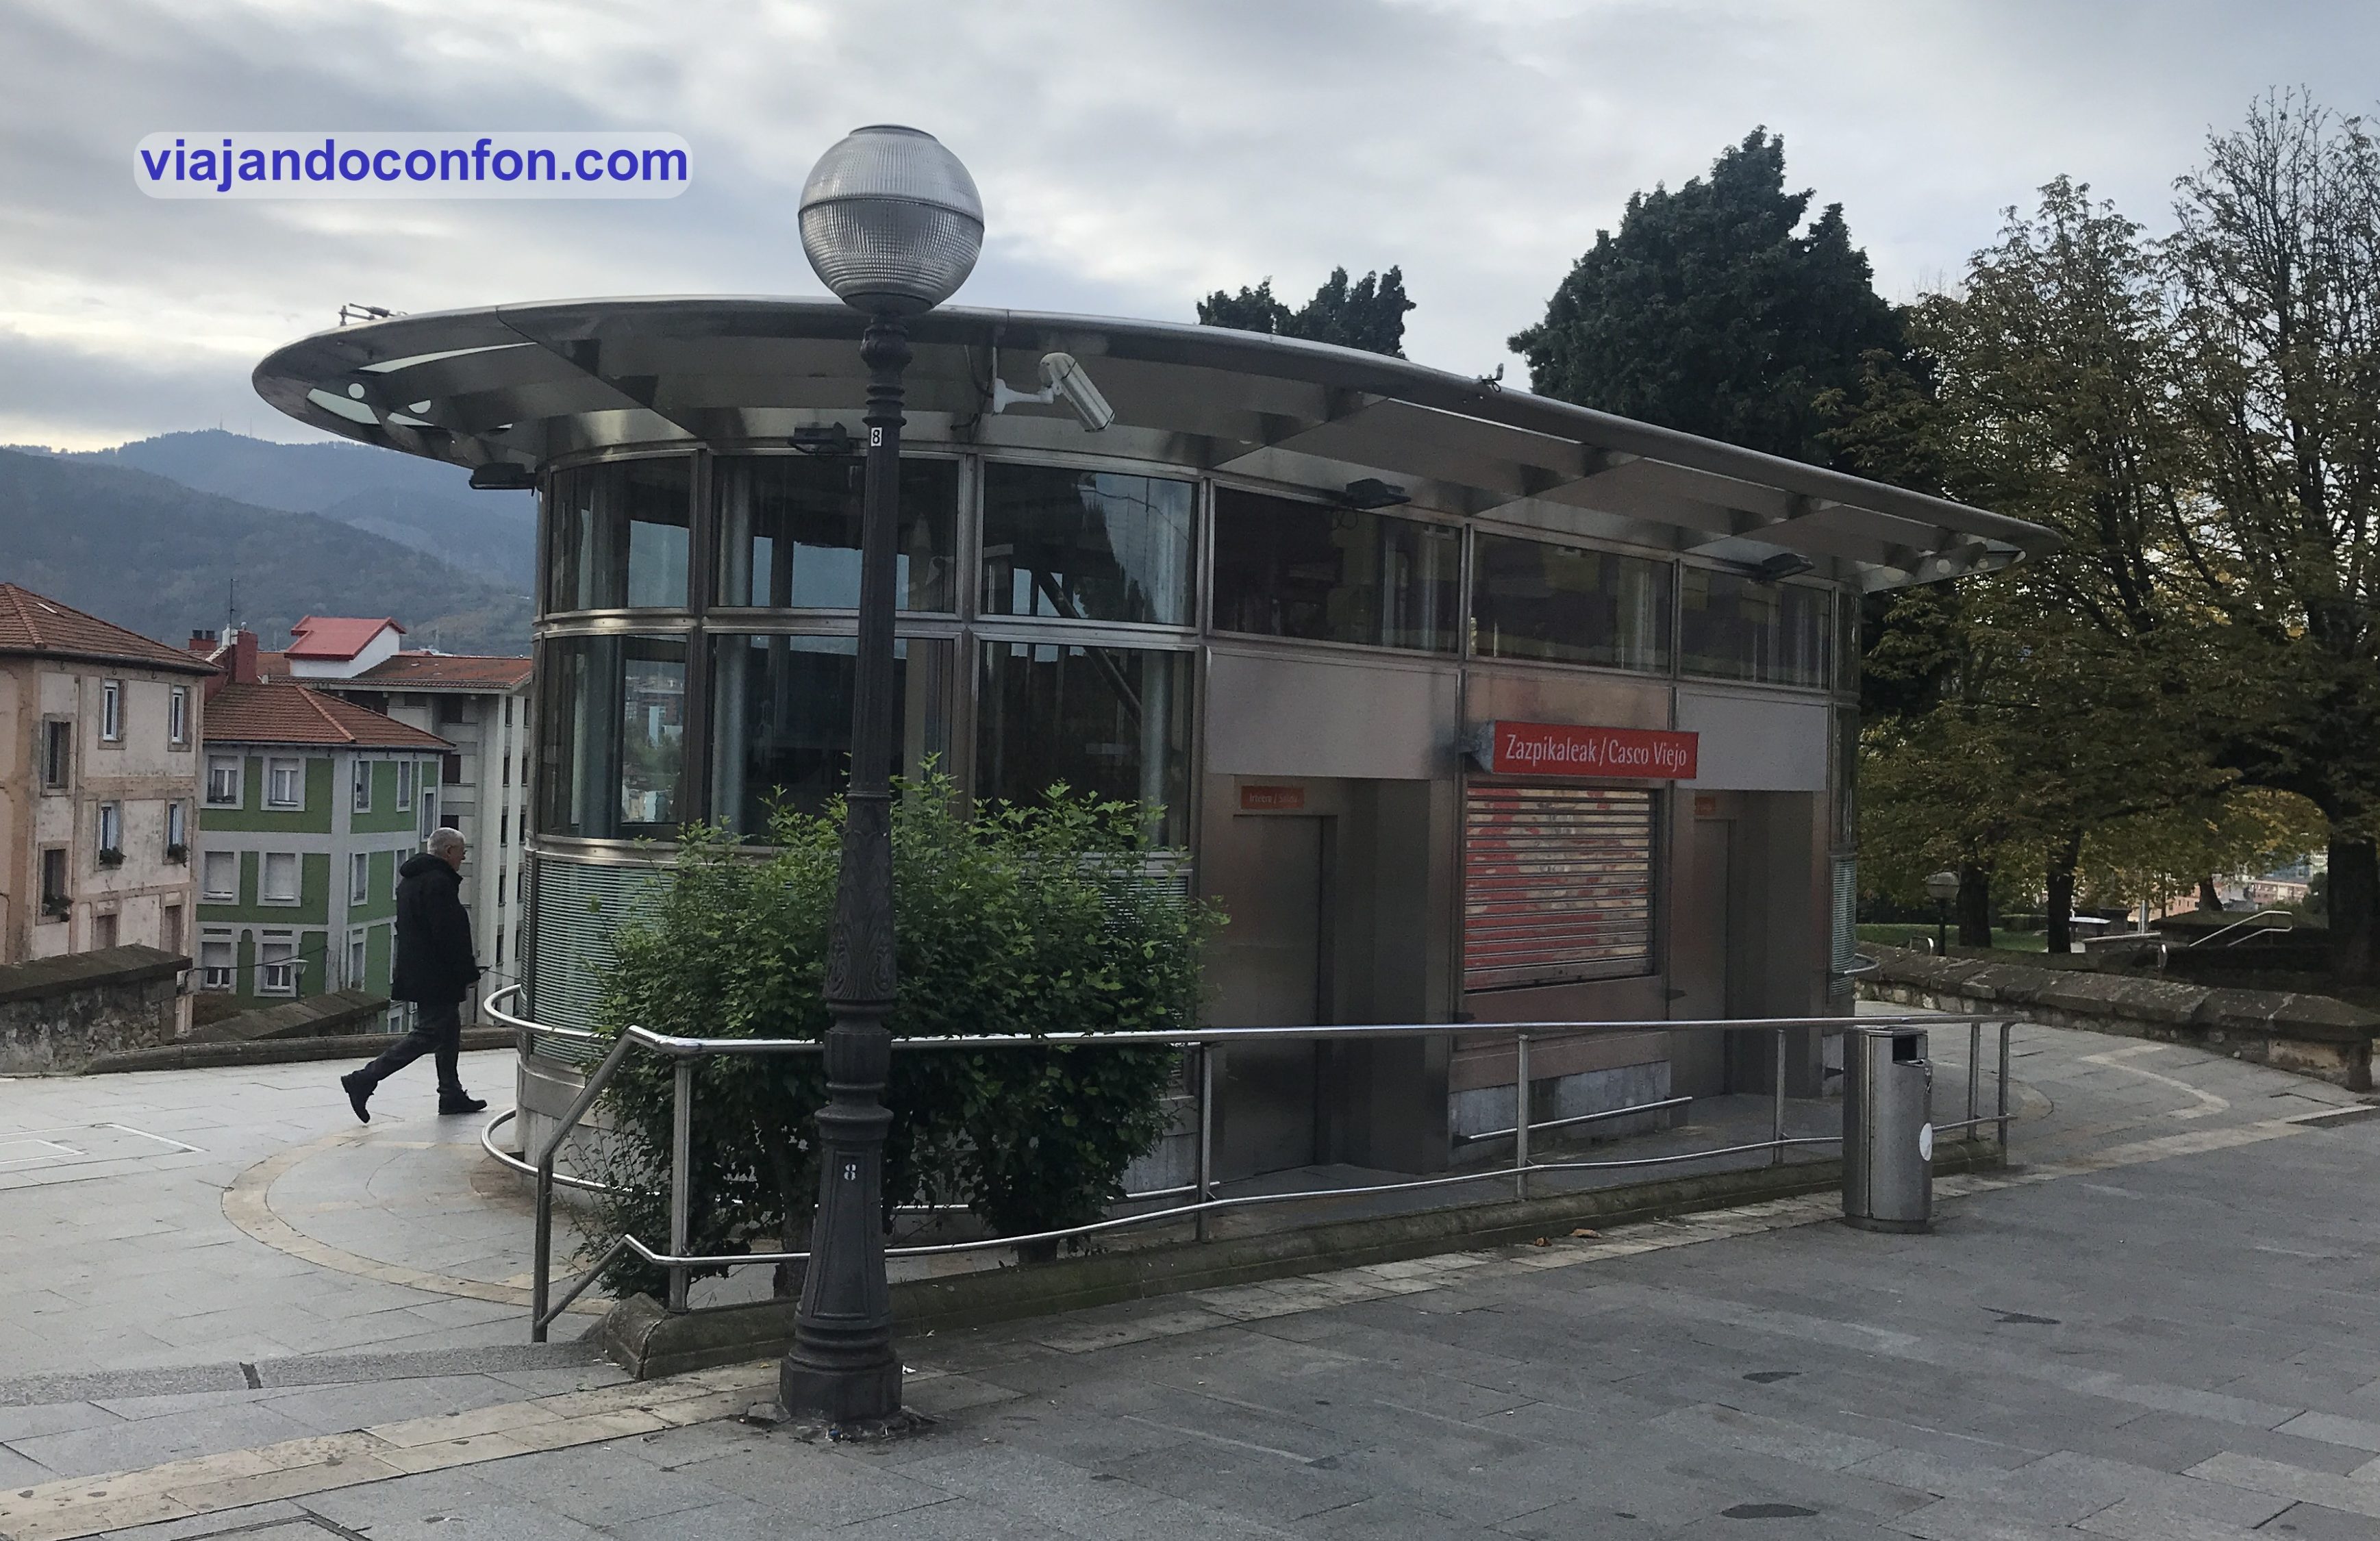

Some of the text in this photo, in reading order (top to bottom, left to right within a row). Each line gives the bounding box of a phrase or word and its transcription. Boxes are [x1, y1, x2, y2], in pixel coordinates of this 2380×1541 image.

[871, 429, 881, 444] 8
[1505, 734, 1596, 766] Zazpikaleak
[1609, 740, 1649, 764] Casco
[1653, 742, 1686, 772] Viejo
[844, 1163, 857, 1181] 8
